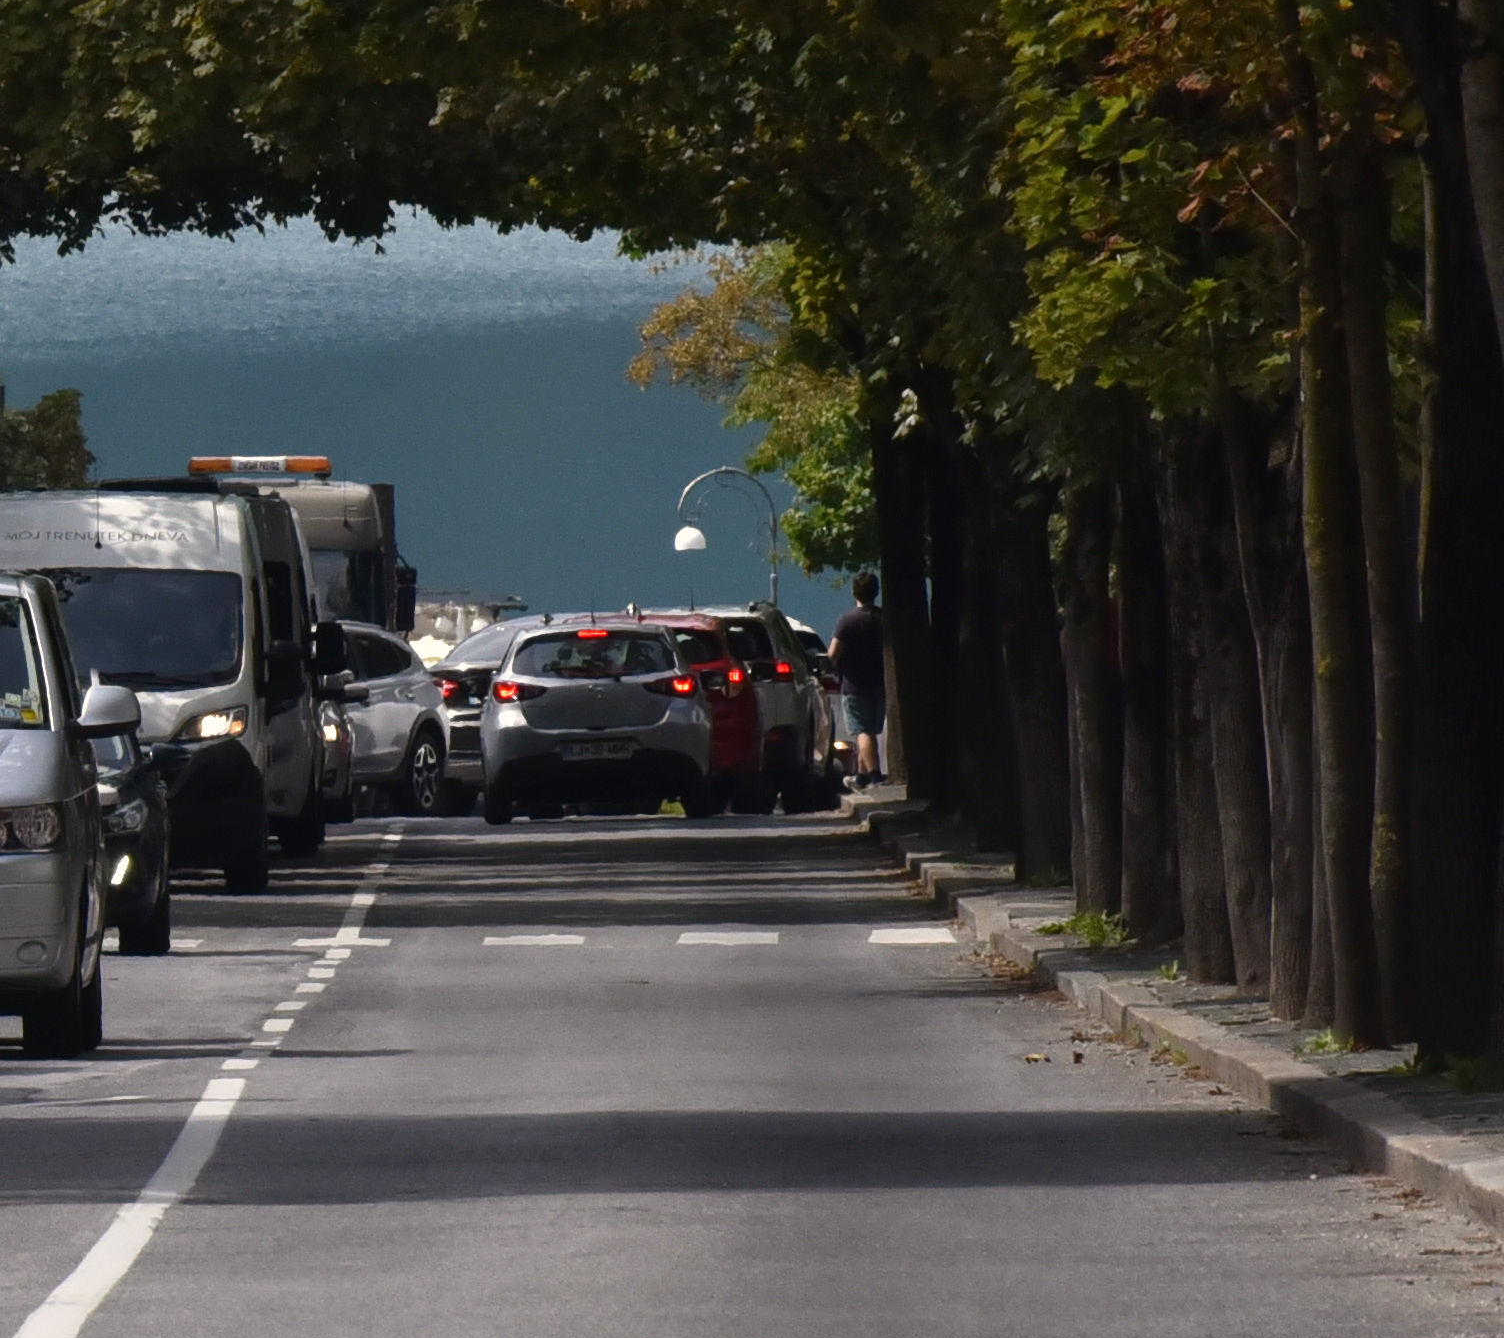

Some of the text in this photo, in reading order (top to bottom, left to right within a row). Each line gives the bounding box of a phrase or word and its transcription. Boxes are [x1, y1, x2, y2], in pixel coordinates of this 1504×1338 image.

[4, 530, 189, 542] MOJ TRENUTEK DNEVA
